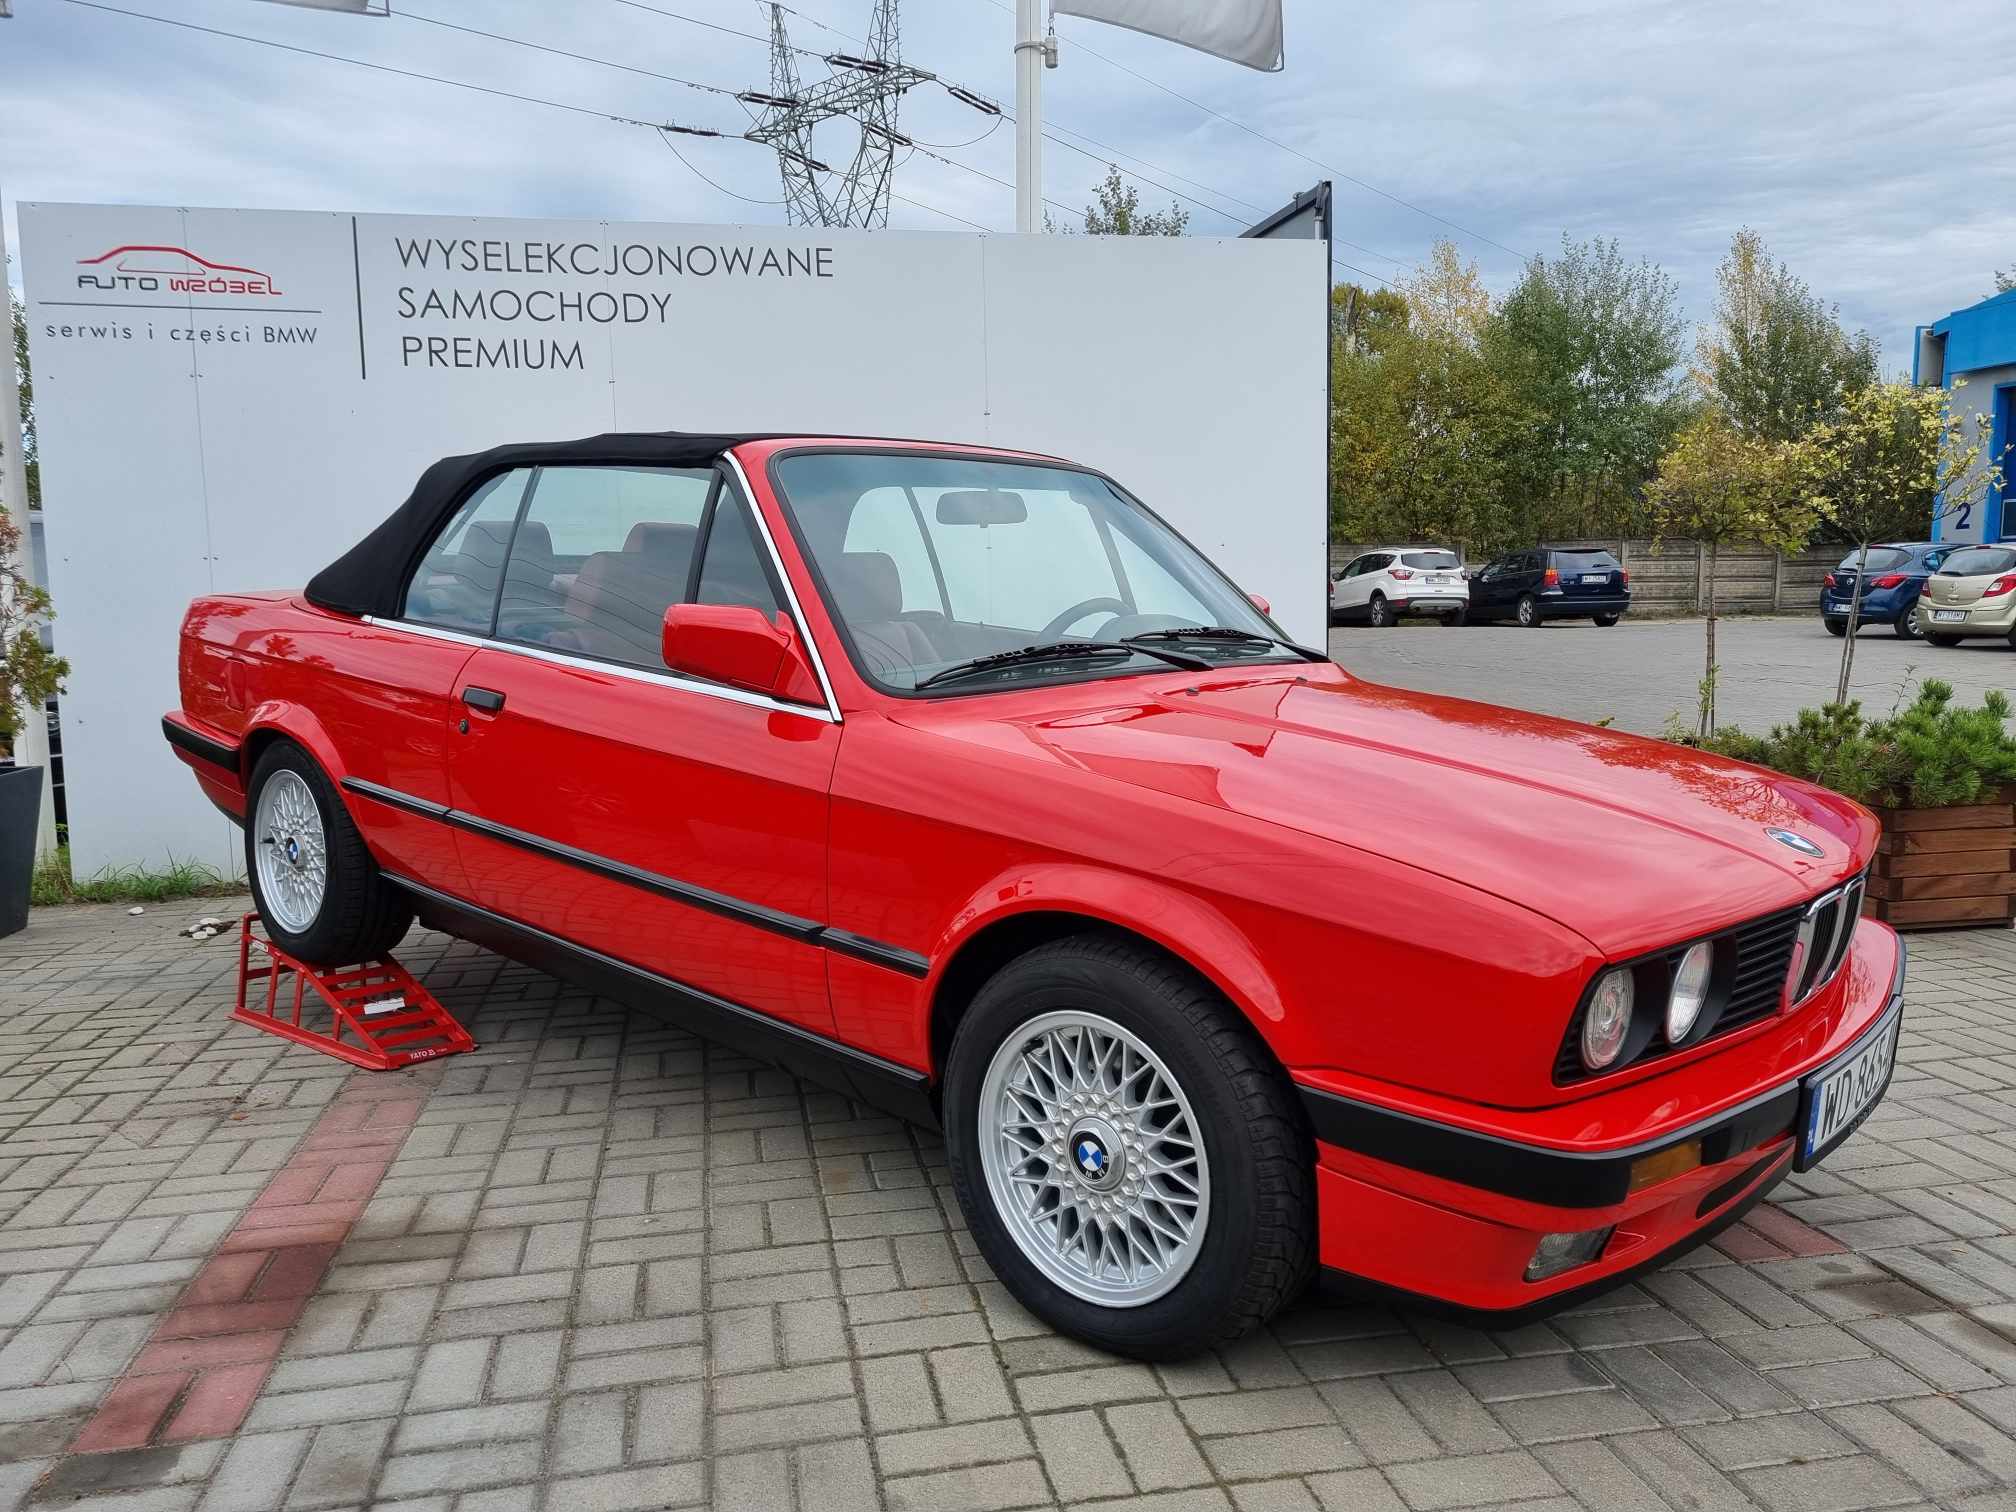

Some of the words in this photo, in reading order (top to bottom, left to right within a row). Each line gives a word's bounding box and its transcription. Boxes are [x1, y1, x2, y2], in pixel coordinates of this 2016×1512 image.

[395, 237, 834, 278] WYSELEKCJONOWANE
[77, 275, 159, 291] AUTO
[398, 286, 673, 324] SAMOCHODY
[46, 321, 133, 340] serwis
[147, 322, 154, 341] i
[170, 324, 250, 345] części
[263, 326, 318, 345] BMW
[402, 336, 585, 370] PREMIUM
[1955, 502, 1972, 530] 2
[1821, 1069, 1852, 1140] WD
